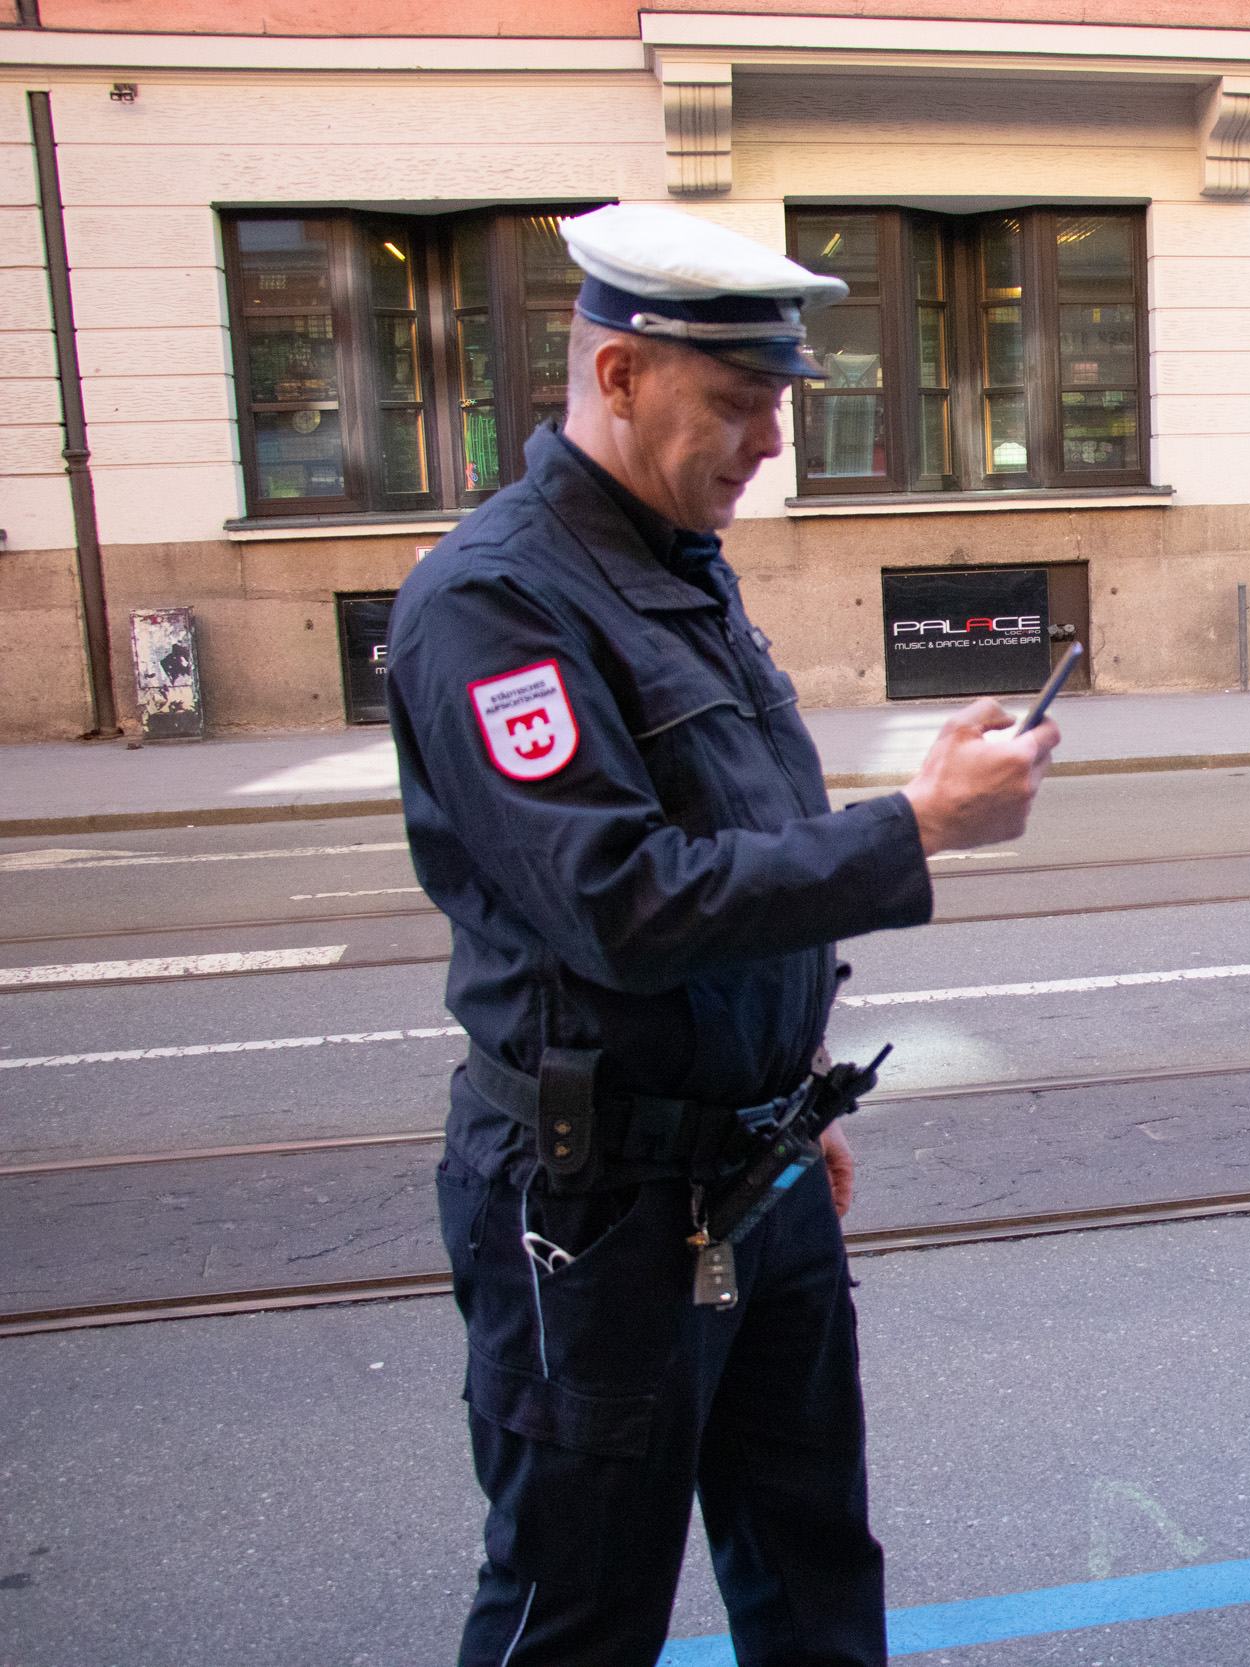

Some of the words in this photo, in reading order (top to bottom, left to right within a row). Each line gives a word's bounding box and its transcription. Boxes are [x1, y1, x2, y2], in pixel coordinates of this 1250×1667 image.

[893, 615, 1041, 636] PALACE
[894, 641, 926, 650] MUSIC
[928, 641, 934, 649] &
[936, 639, 970, 648] DANCE
[979, 637, 1018, 646] LOUNGE
[1020, 636, 1041, 644] BAR
